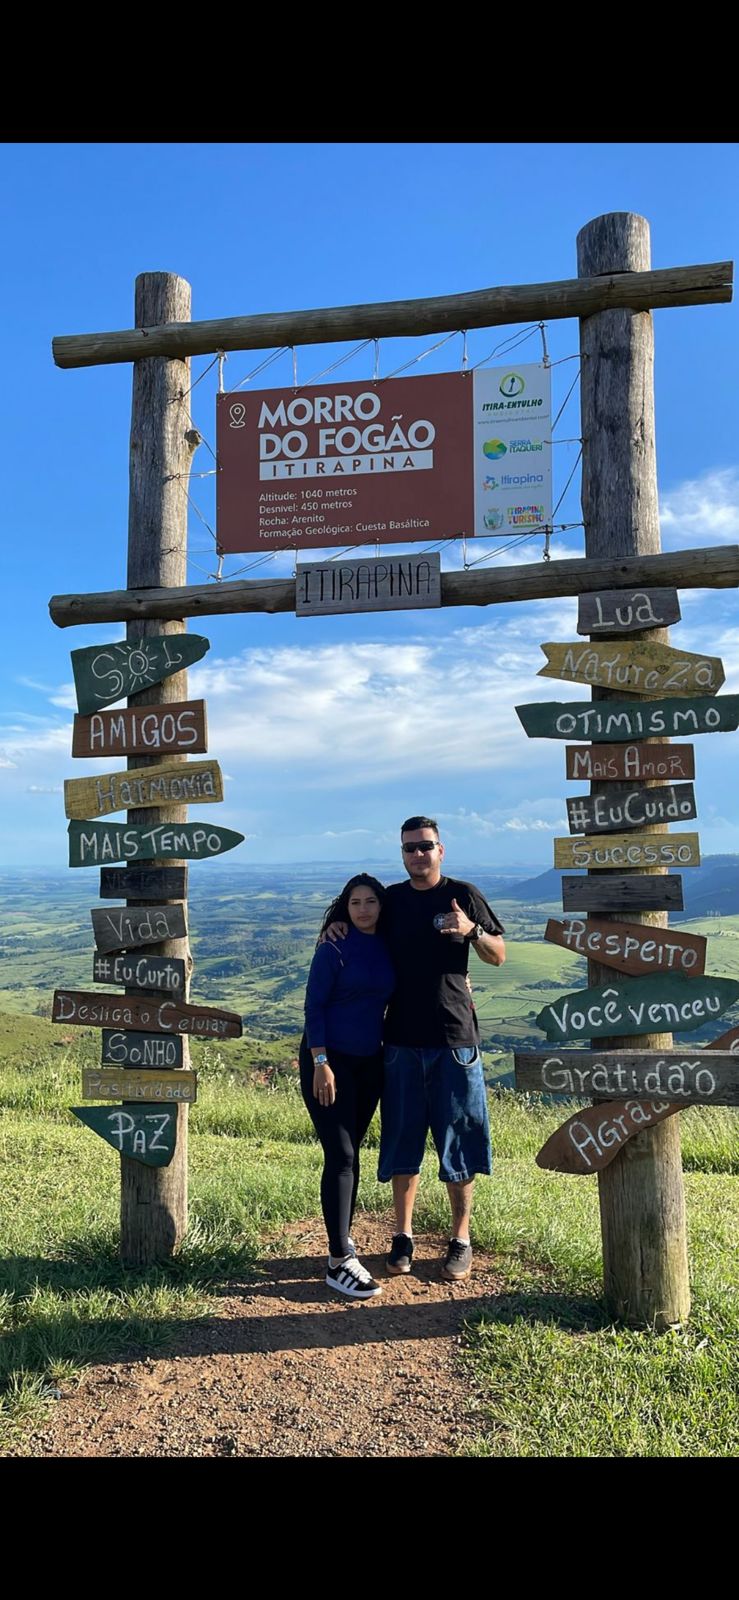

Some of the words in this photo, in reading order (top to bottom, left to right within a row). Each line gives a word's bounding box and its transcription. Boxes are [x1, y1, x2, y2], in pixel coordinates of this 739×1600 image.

[258, 392, 381, 429] MORRO
[482, 399, 543, 411] ITIRA-ENTULHO
[260, 431, 308, 460] DO
[319, 414, 436, 457] FOGÃO
[272, 455, 415, 477] ITIRAPINA
[501, 473, 544, 486] Itirapina
[259, 493, 297, 502] Altitude:
[300, 490, 323, 499] 1040
[326, 488, 357, 497] metros
[259, 503, 298, 514] Desnível:
[301, 502, 318, 511] 450
[321, 501, 353, 510] metros
[259, 516, 289, 526] Rocha:
[291, 515, 325, 524] Arenito
[259, 527, 303, 538] Formação
[305, 525, 353, 536] Geológica:
[355, 522, 386, 532] Cuesta
[389, 518, 430, 530] Basáltica
[301, 562, 432, 604] ITIRAPINA
[592, 593, 664, 628] Lua
[91, 641, 183, 700] SOL
[90, 711, 198, 750] AMIGOS
[556, 707, 721, 735] OTIMISMO
[80, 831, 138, 861] MAIS
[141, 826, 222, 853] TEMPO
[106, 912, 176, 942] Vida
[140, 1012, 150, 1024] o
[158, 1001, 228, 1033] Celular
[550, 988, 622, 1033] Você
[628, 996, 721, 1025] venceu
[87, 1073, 191, 1097] Positividade
[541, 1057, 717, 1096] Gratidão
[107, 1111, 170, 1154] PAZ
